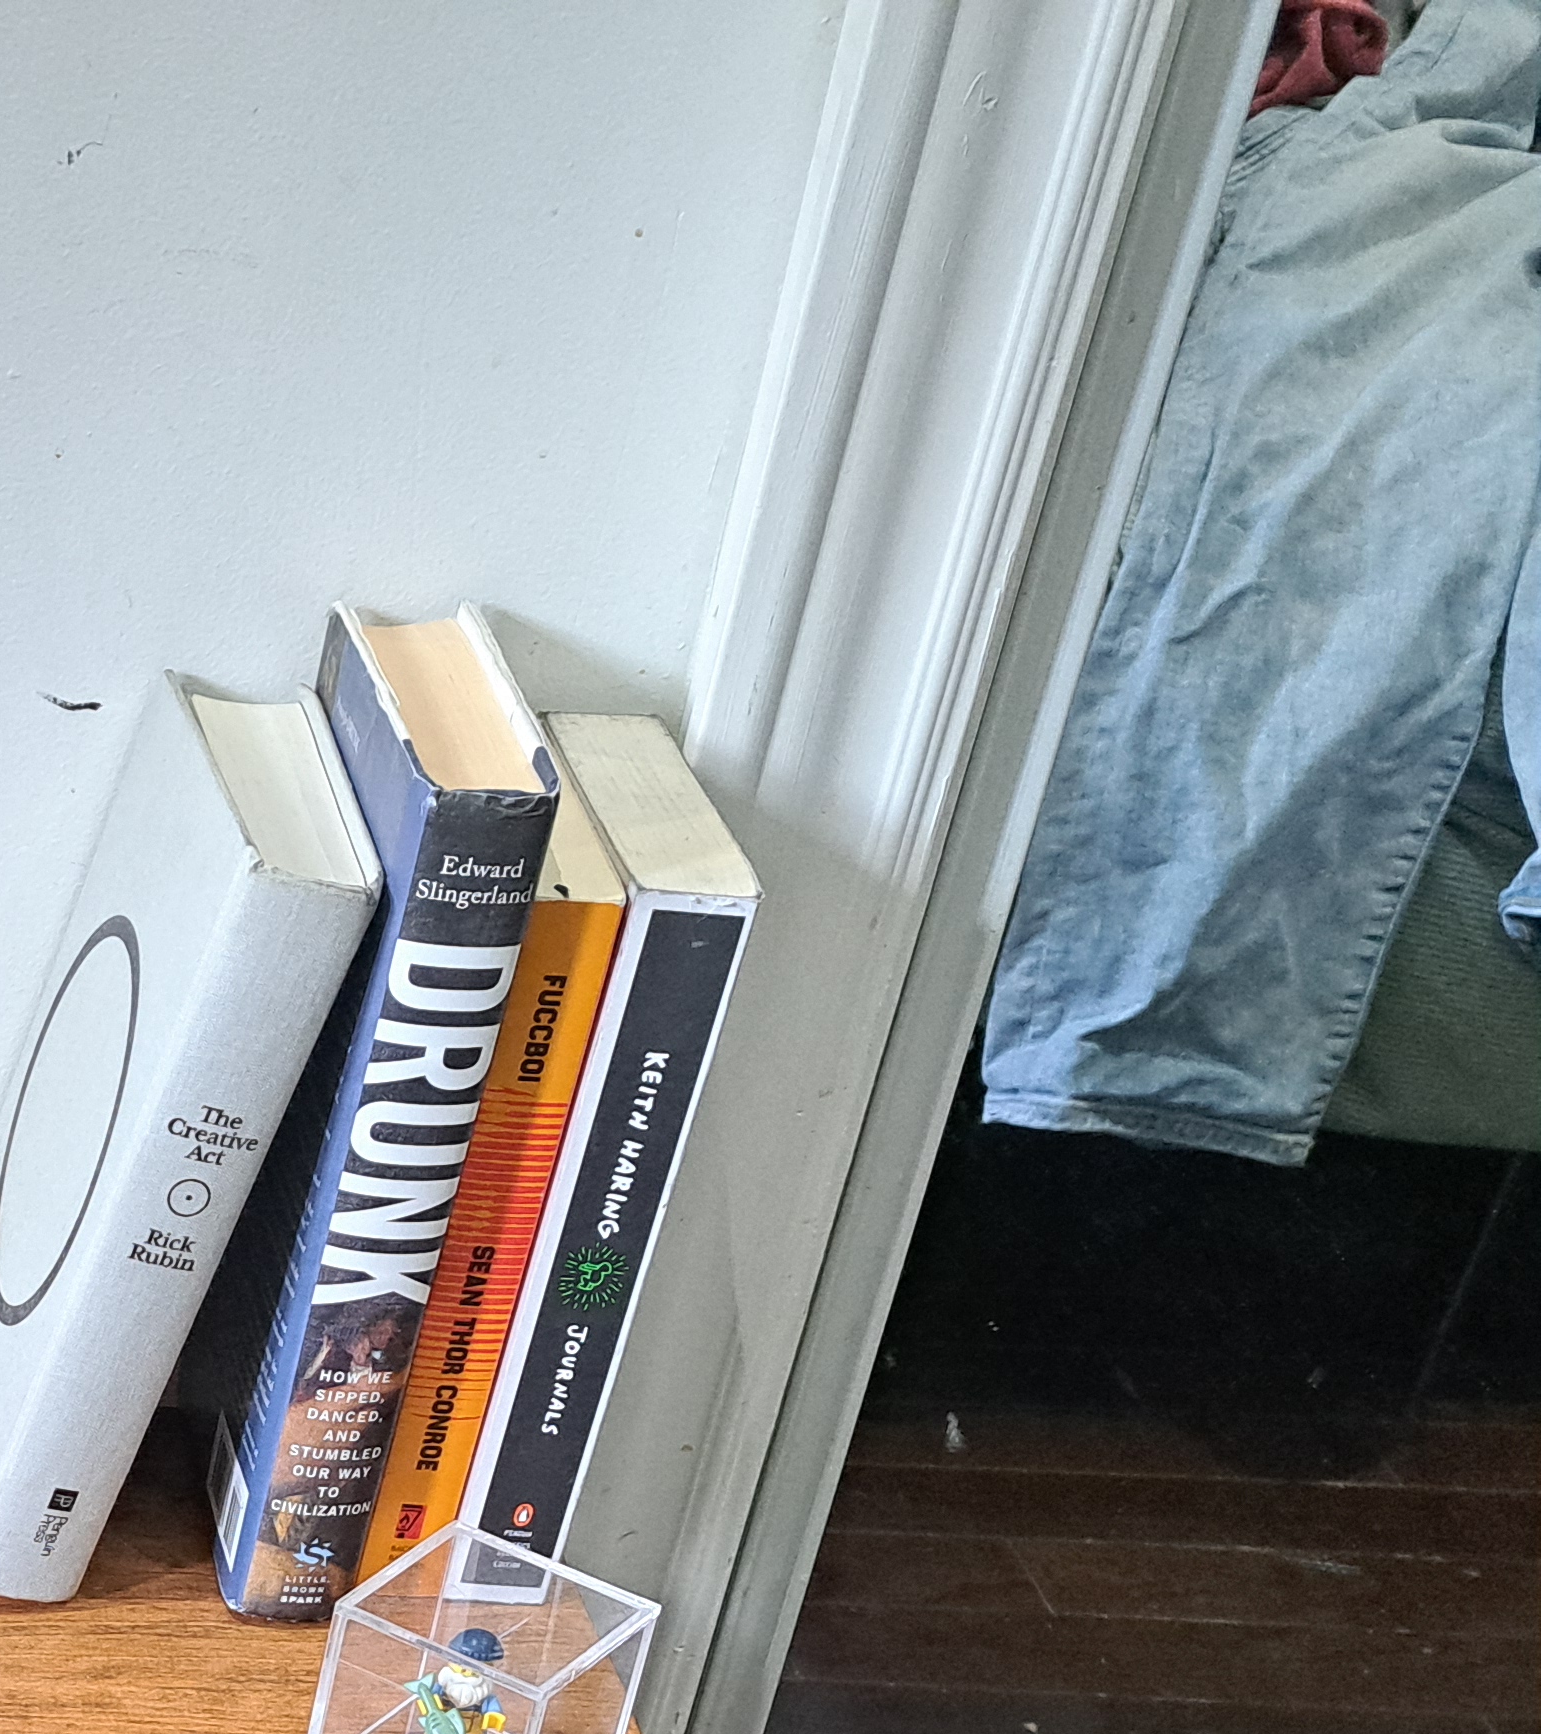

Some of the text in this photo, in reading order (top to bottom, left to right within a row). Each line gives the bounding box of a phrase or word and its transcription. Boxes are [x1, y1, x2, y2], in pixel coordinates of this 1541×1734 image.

[440, 854, 525, 878] Edward
[415, 878, 534, 910] Slingerland
[517, 974, 568, 1083] FUCCBOI
[201, 1105, 244, 1130] The
[311, 938, 521, 1305] DRUNK
[167, 1117, 259, 1151] Creative
[597, 1051, 670, 1239] KEITH HARING
[184, 1144, 226, 1166] Act
[144, 1228, 197, 1253] Rick
[128, 1243, 195, 1272] Rubin
[415, 1246, 496, 1472] SEAN THOR CONROE
[319, 1369, 393, 1385] HOW WE
[541, 1323, 589, 1436] JOURNALS
[315, 1389, 385, 1405] SIPPED,
[307, 1407, 383, 1423] DANCED,
[323, 1429, 361, 1442] AND
[289, 1444, 382, 1461] STUMBLED
[292, 1464, 372, 1480] OUR WAY
[317, 1486, 340, 1498] TO
[271, 1499, 372, 1517] CIVILIZATION
[33, 1513, 58, 1543] Press
[40, 1516, 69, 1557] Penguin
[280, 1596, 323, 1604] SPARK
[283, 1586, 325, 1594] BROWN
